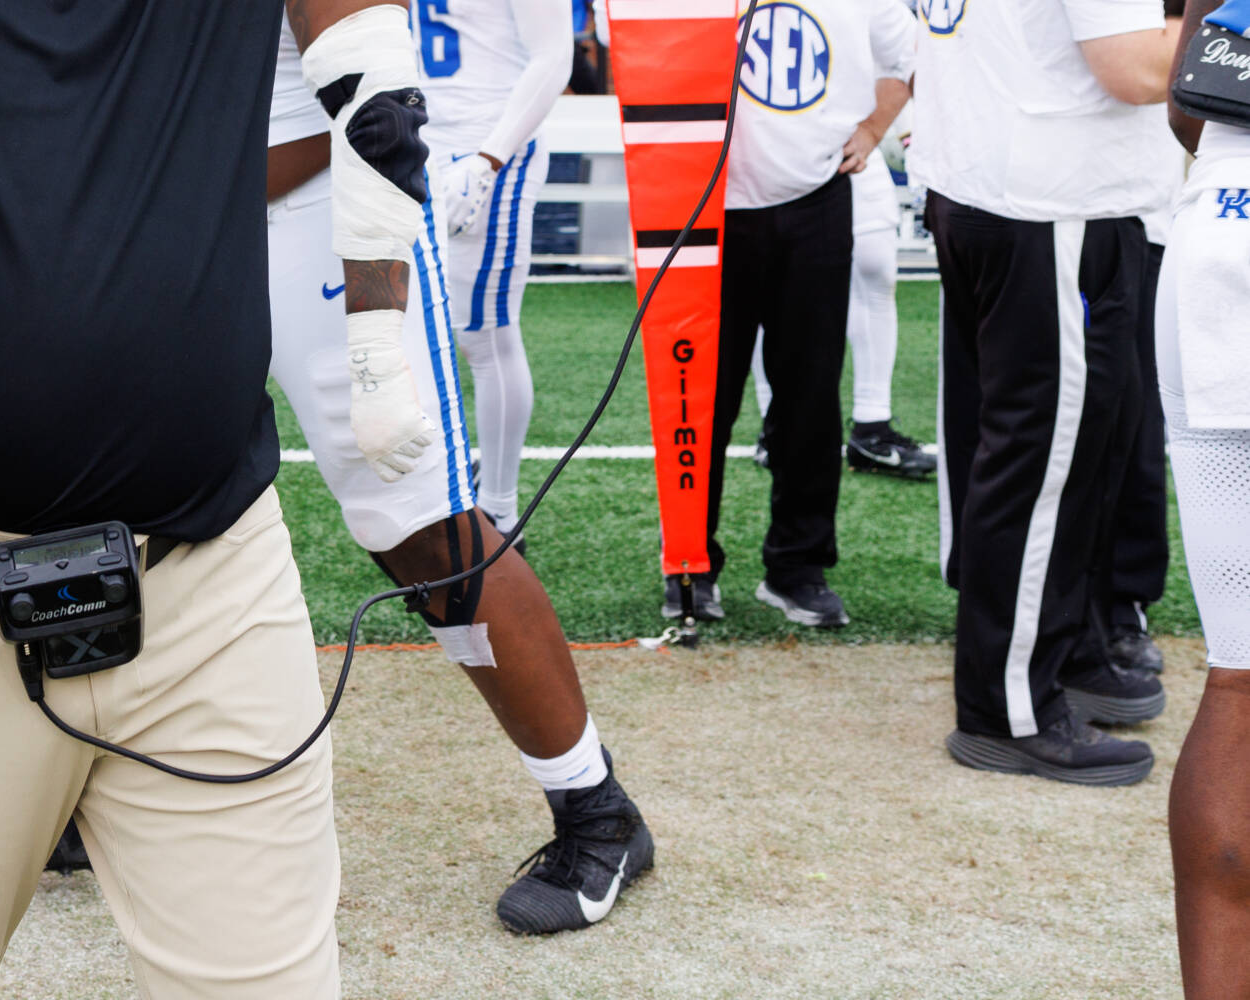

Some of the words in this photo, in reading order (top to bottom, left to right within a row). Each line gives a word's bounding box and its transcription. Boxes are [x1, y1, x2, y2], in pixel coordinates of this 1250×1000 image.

[738, 4, 828, 109] SEC
[672, 338, 696, 490] Gilman
[30, 599, 107, 623] CoachComm
